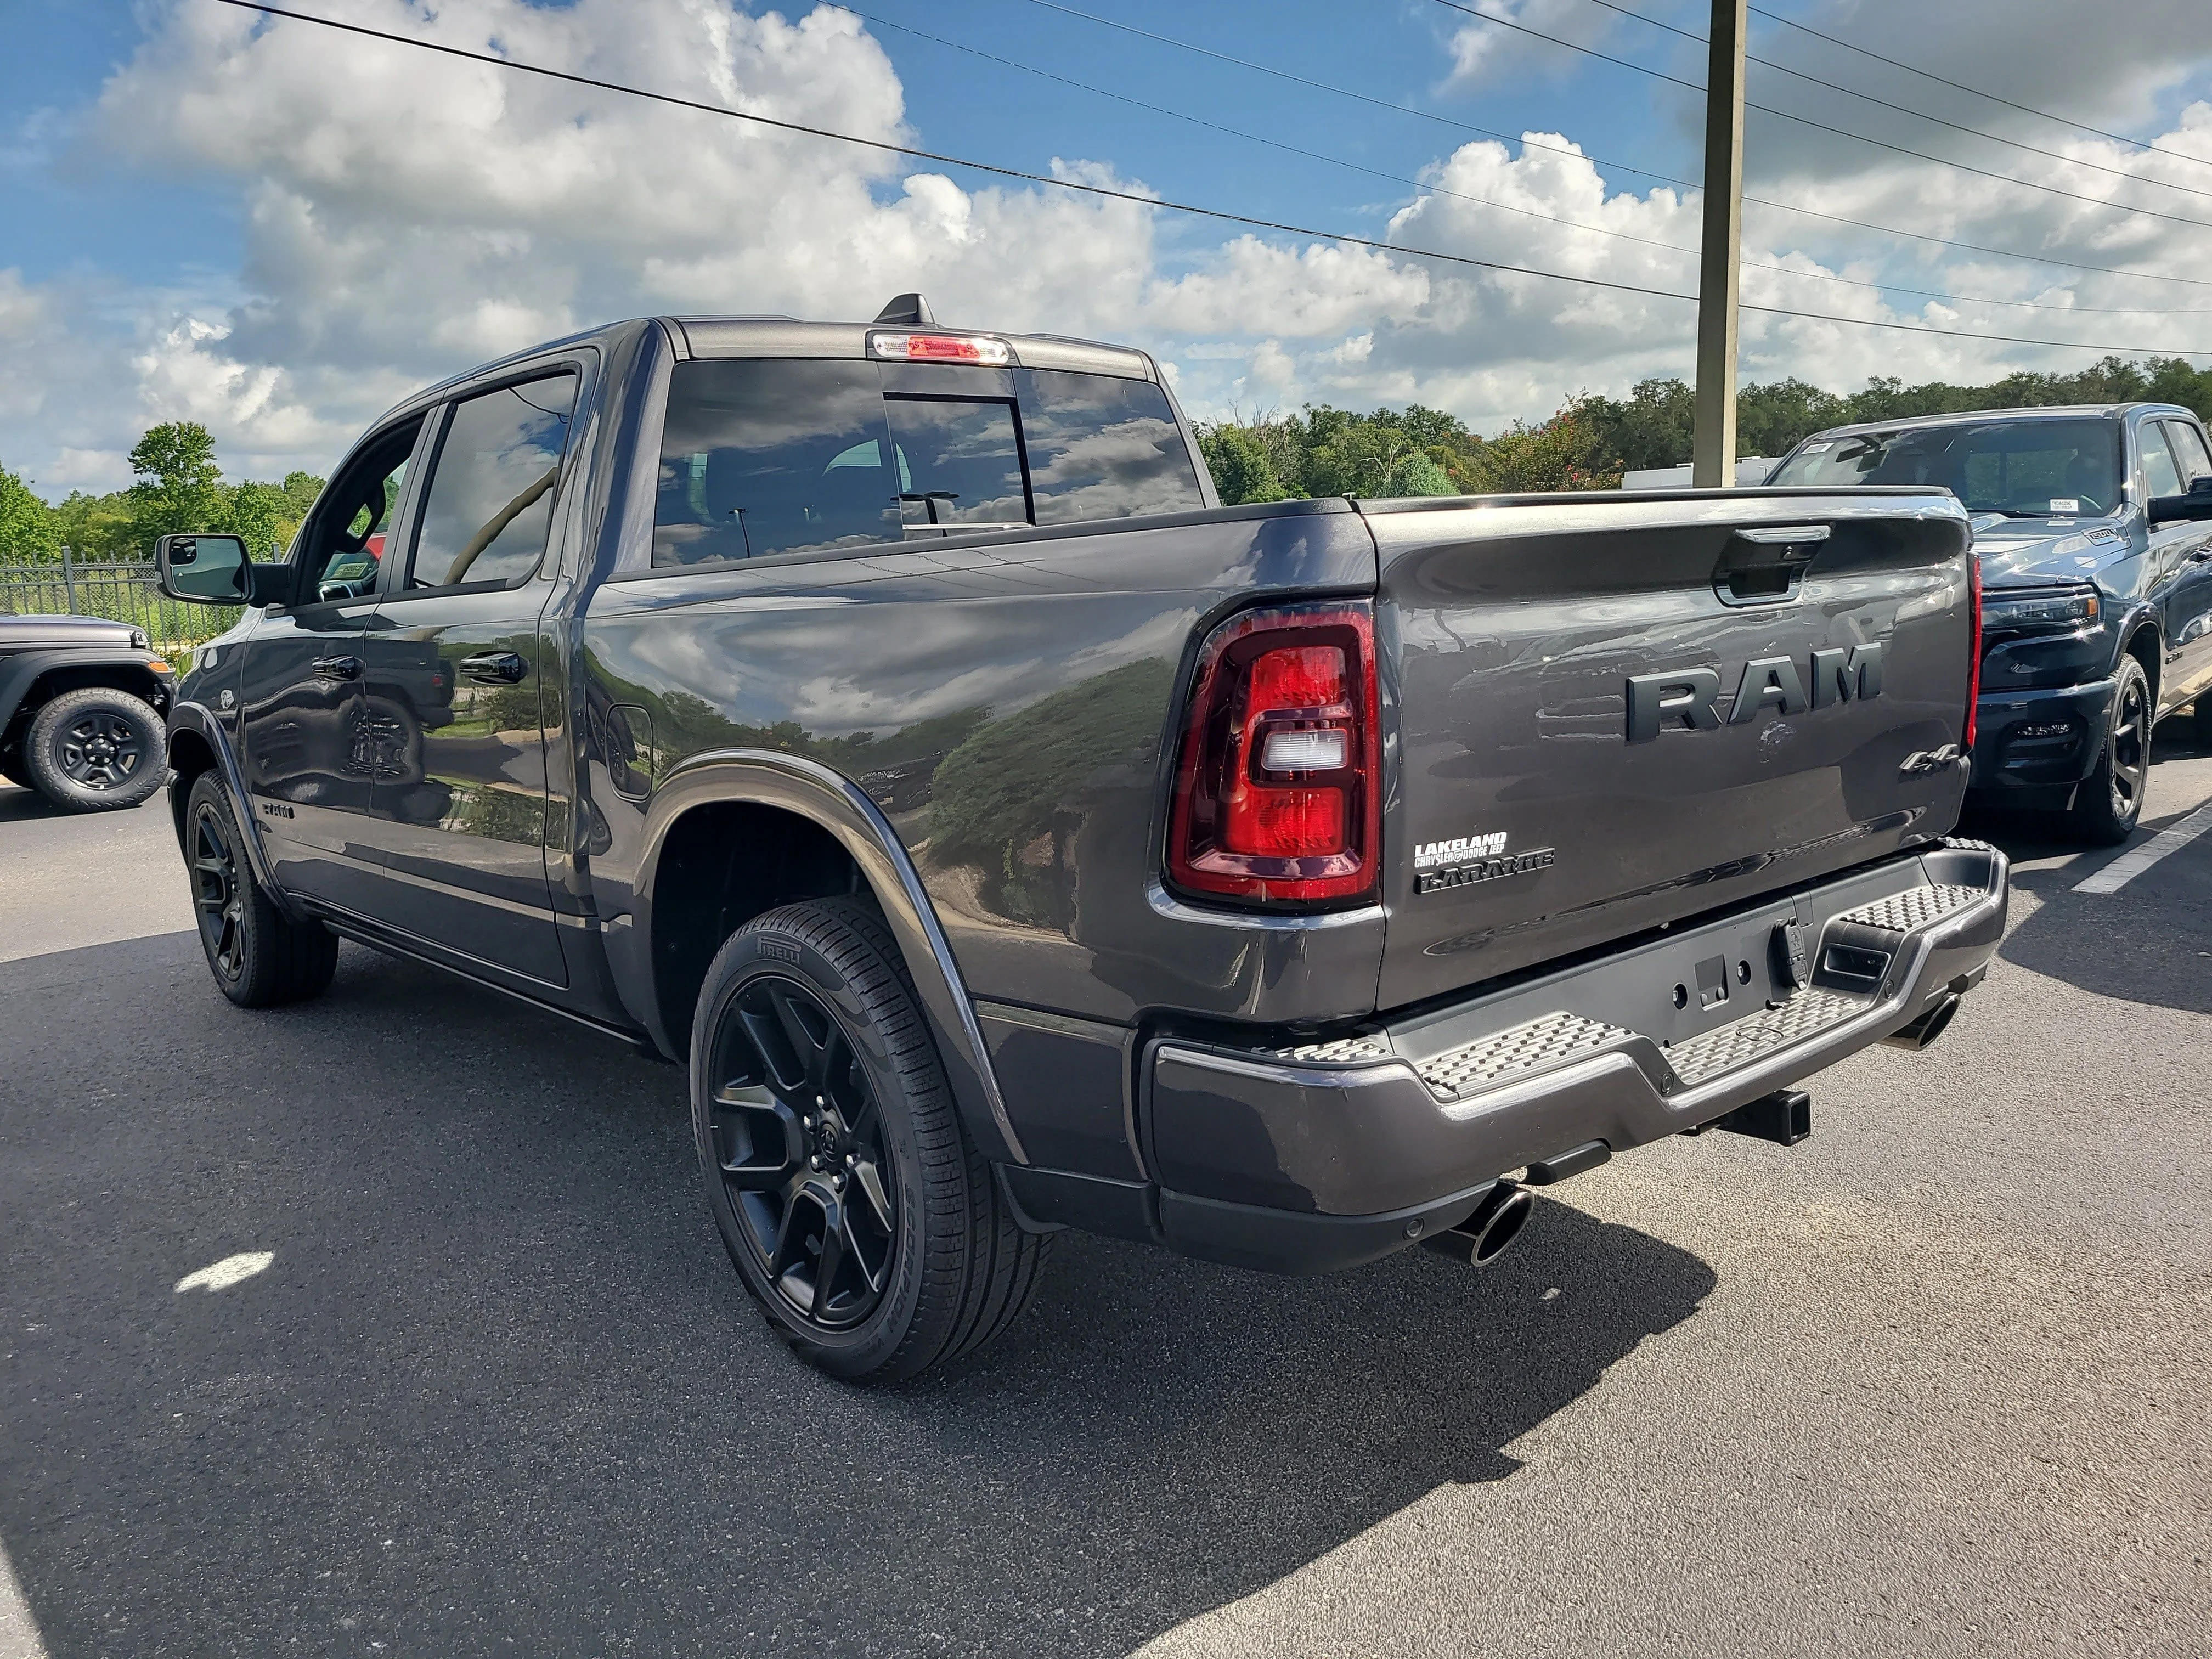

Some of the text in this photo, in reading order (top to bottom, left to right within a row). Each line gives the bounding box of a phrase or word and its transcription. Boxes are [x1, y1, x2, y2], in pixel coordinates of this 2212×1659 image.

[2089, 529, 2112, 539] 1500
[1626, 641, 1882, 742] RAM
[262, 803, 295, 819] RAM
[1414, 831, 1508, 857] LAKELAND
[1414, 843, 1505, 868] CHRYSLER DODGE JEEP
[1414, 847, 1555, 895] LARAMIE
[757, 935, 802, 965] PIRELLI
[887, 1182, 917, 1334] SCORPION
